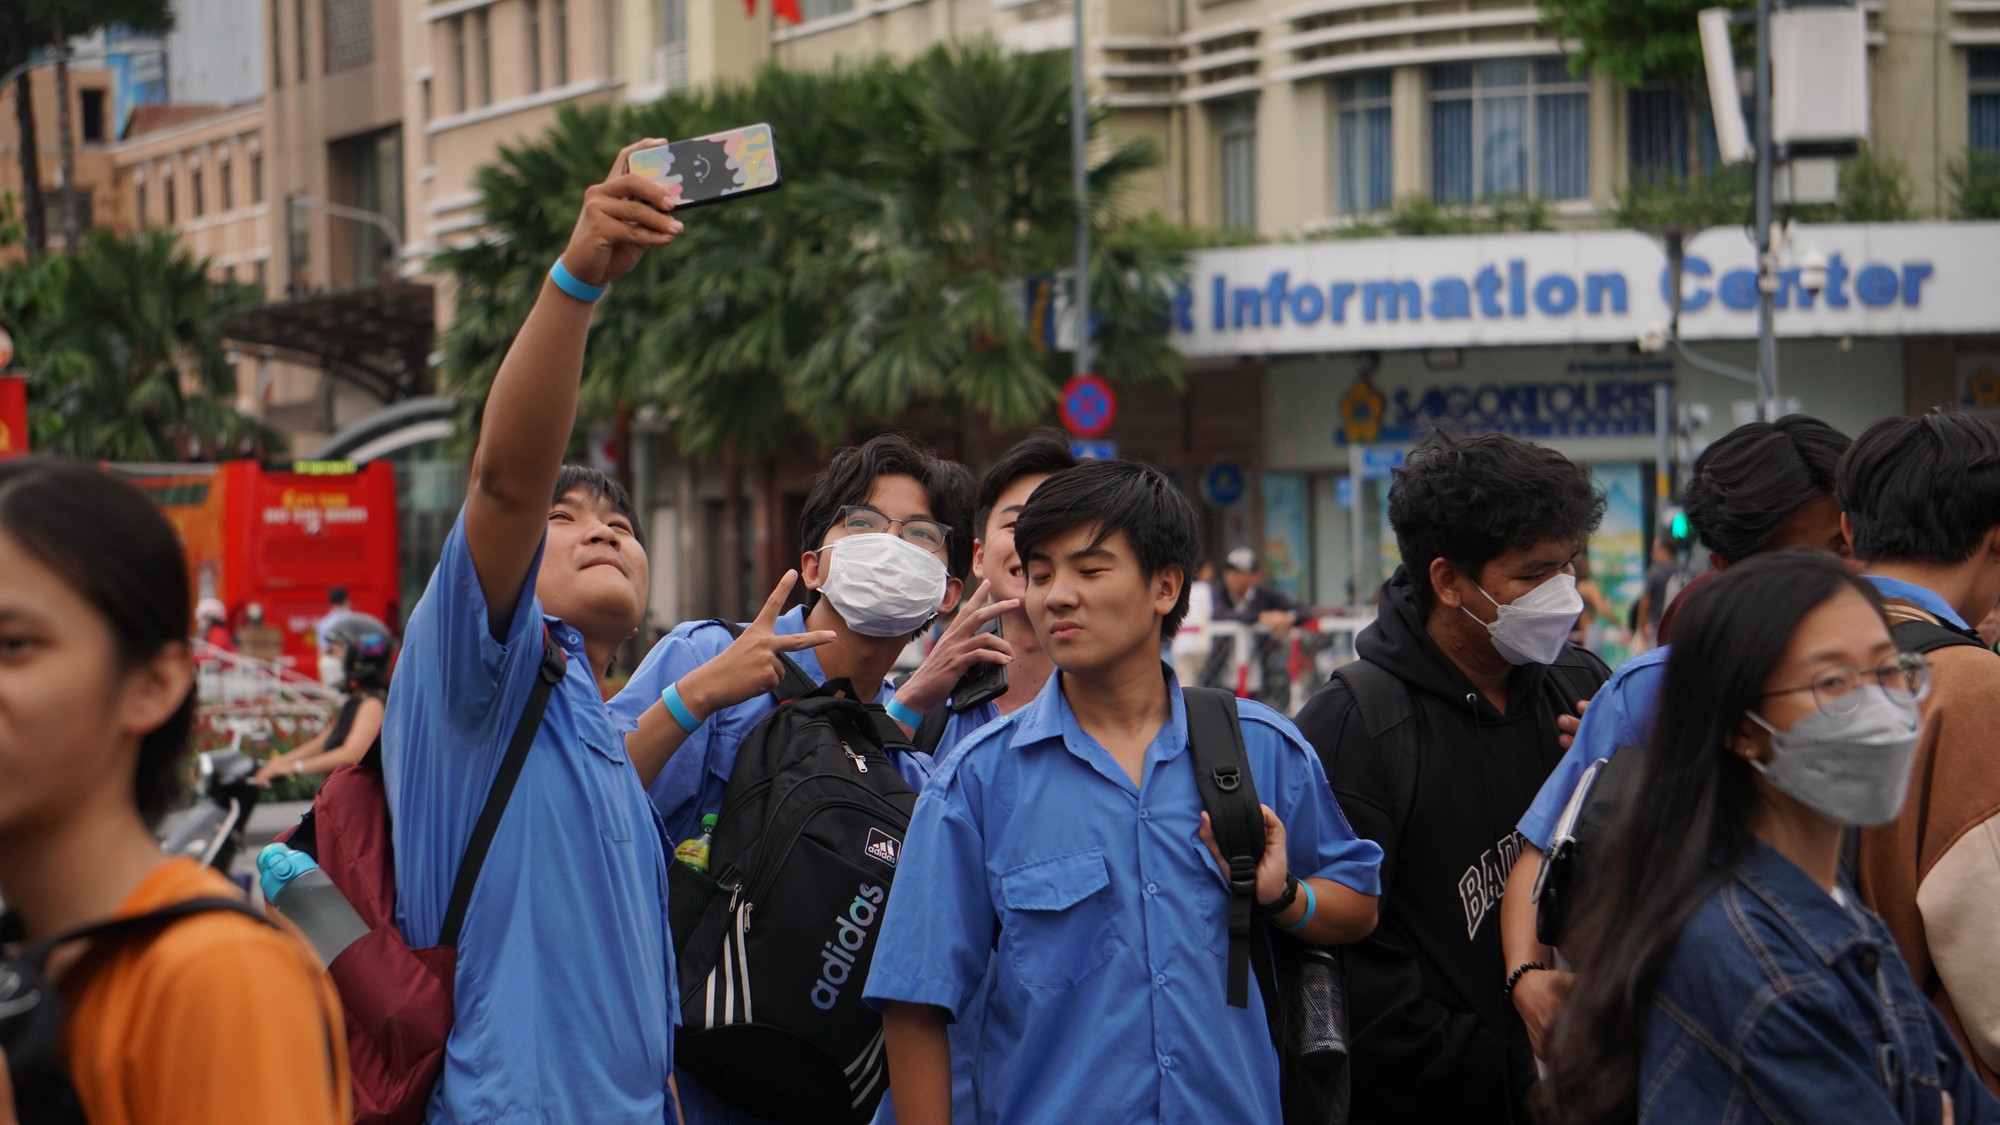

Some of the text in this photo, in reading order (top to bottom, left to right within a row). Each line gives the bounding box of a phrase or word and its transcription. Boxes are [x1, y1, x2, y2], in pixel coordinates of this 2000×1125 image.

[1211, 259, 1628, 331] Information
[1659, 250, 1933, 313] Center
[867, 845, 896, 864] adidas
[810, 882, 884, 1010] adidas
